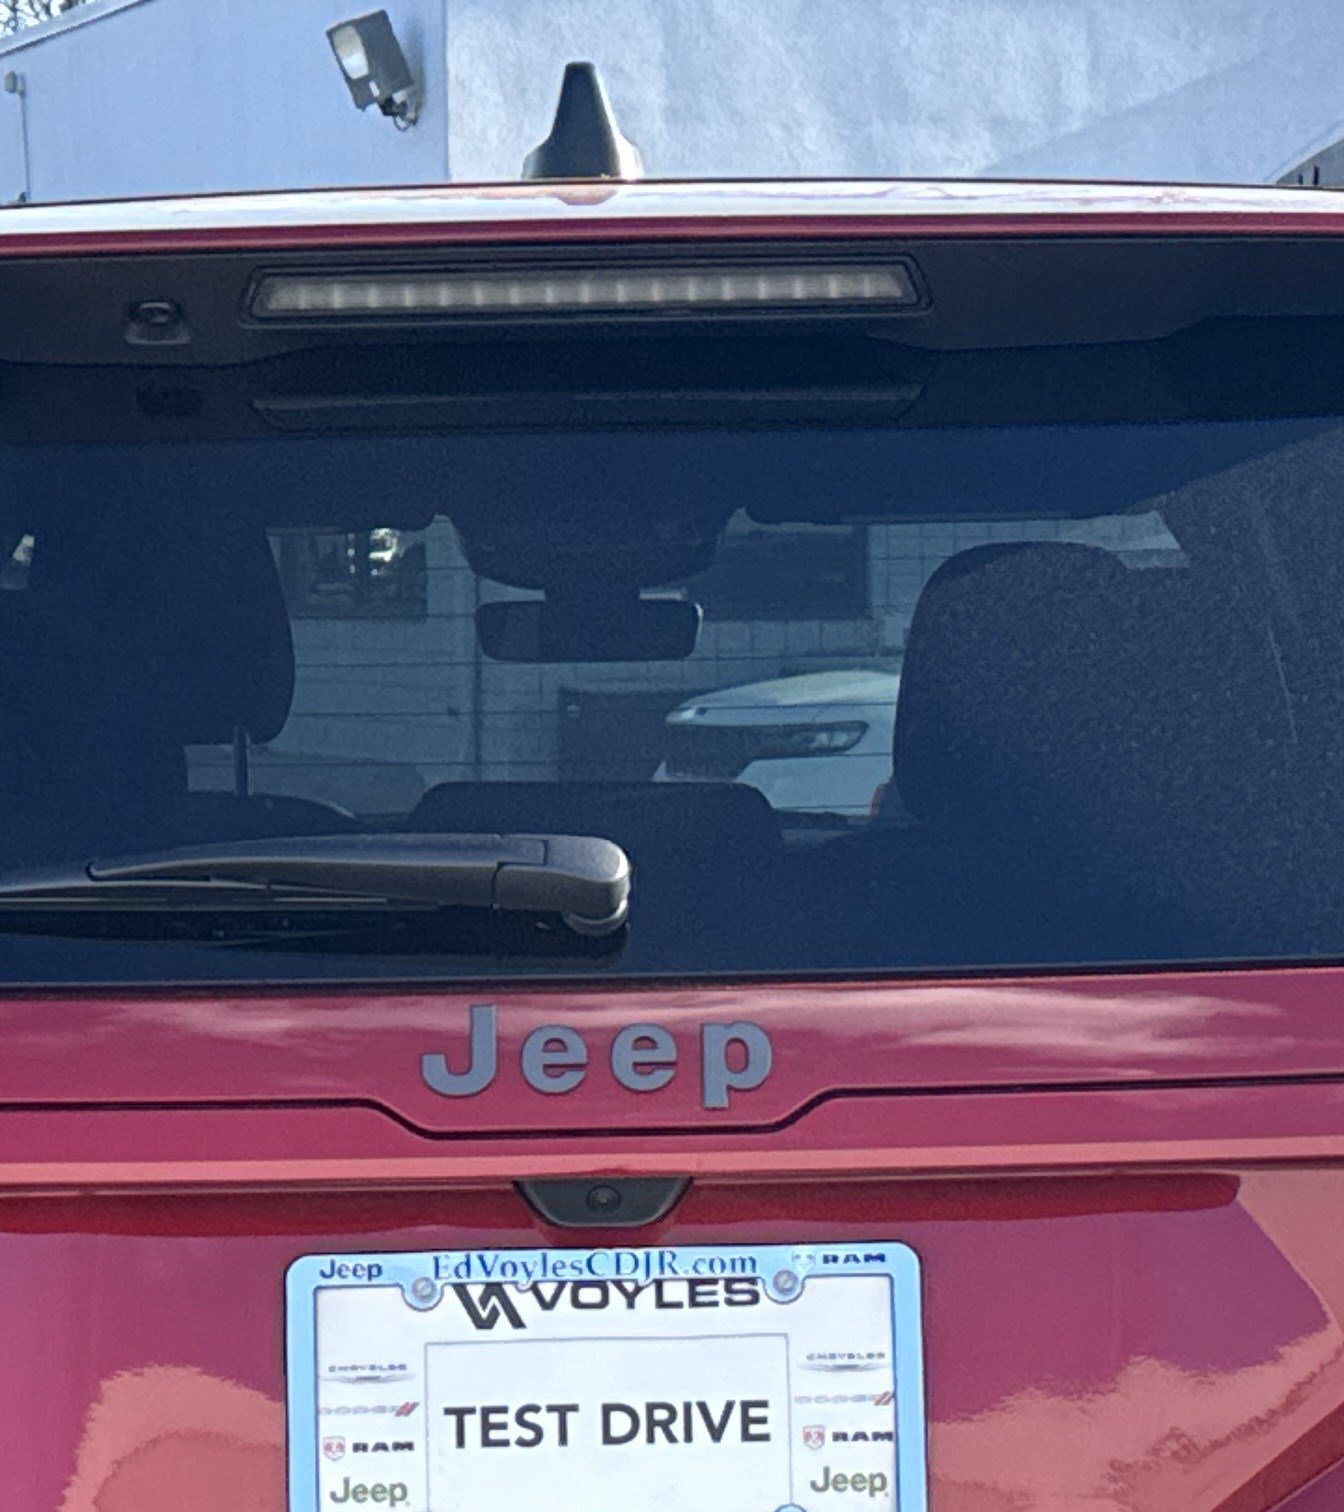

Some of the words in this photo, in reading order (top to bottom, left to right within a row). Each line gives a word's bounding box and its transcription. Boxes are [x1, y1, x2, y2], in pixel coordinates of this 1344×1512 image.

[420, 1003, 773, 1110] Jeep
[319, 1258, 384, 1282] Jeep
[432, 1249, 758, 1282] EdVoylesCDJR.com
[822, 1252, 887, 1264] RAM
[530, 1277, 760, 1311] VOYLES
[444, 1404, 579, 1449] TEST
[601, 1399, 772, 1446] DRIVE
[831, 1431, 893, 1442] RAM
[352, 1440, 414, 1453] RAM
[329, 1476, 408, 1508] Jeep
[809, 1465, 888, 1498] Jeep
